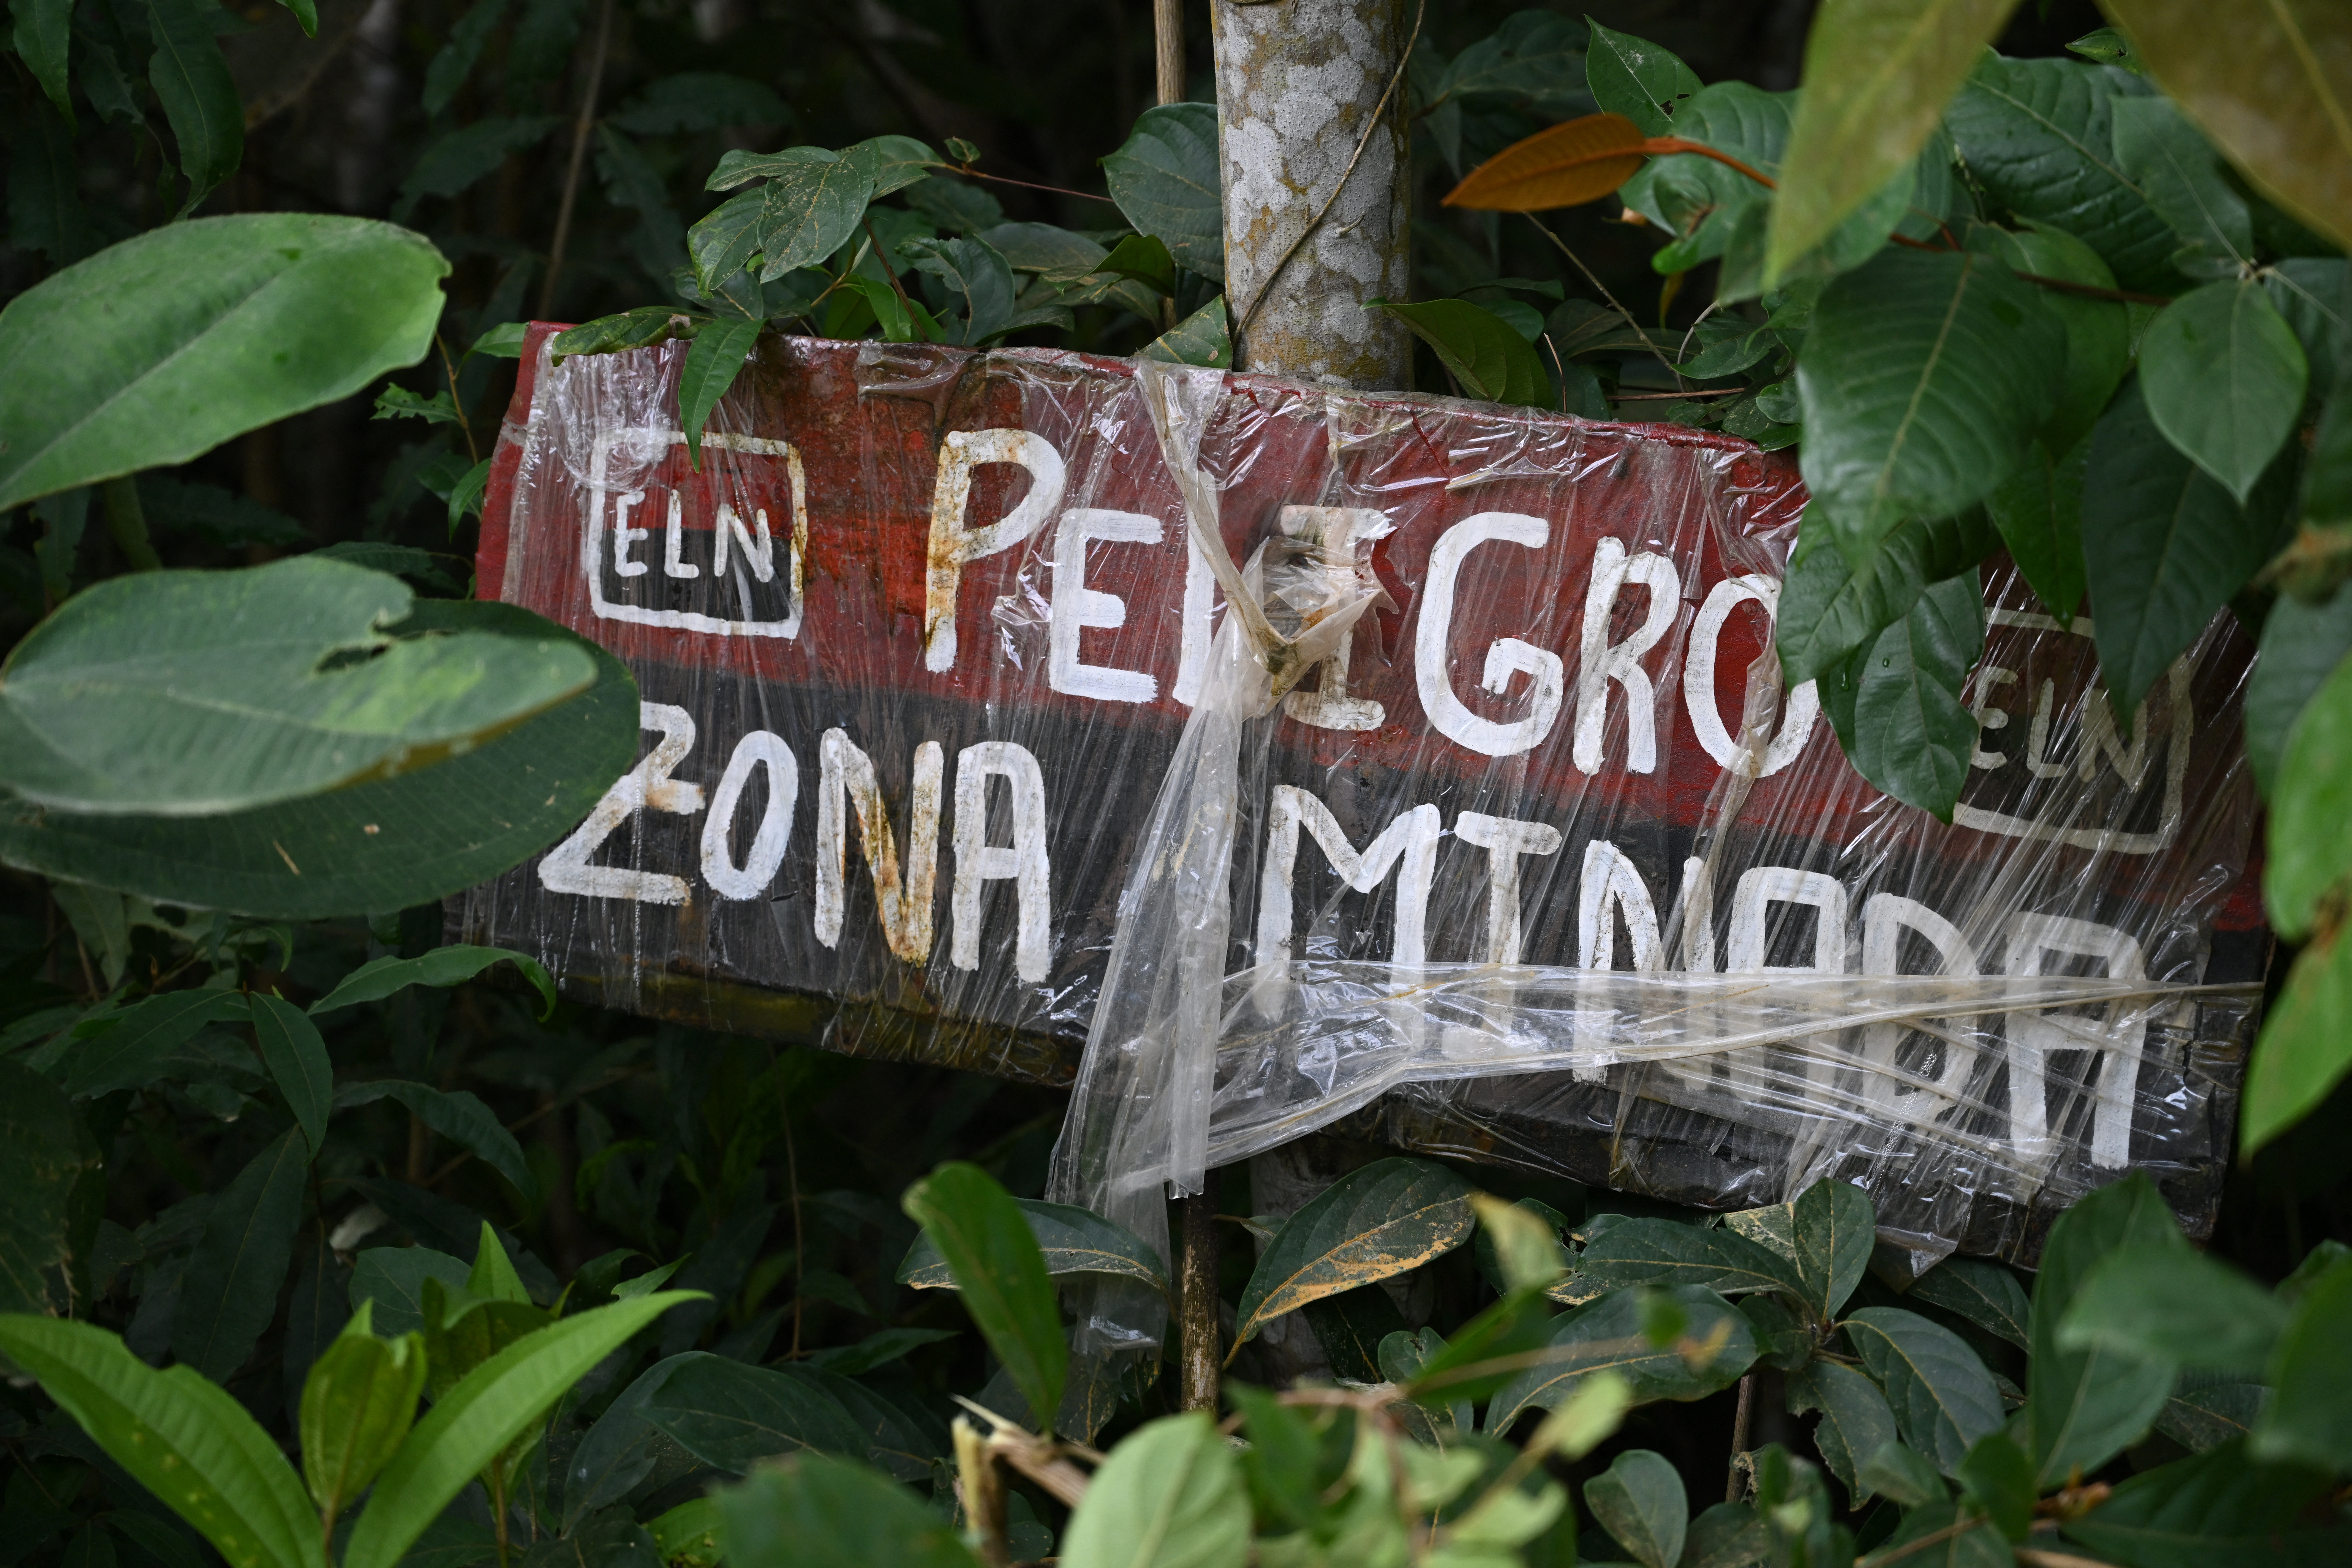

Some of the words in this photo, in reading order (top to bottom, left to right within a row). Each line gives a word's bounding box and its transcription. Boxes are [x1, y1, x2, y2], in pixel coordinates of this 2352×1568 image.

[614, 489, 774, 583] ELN
[925, 428, 1819, 777] PELIGRO
[1971, 666, 2148, 793] ELN
[537, 701, 1052, 984] ZONA
[1253, 784, 2147, 1170] MINADA
